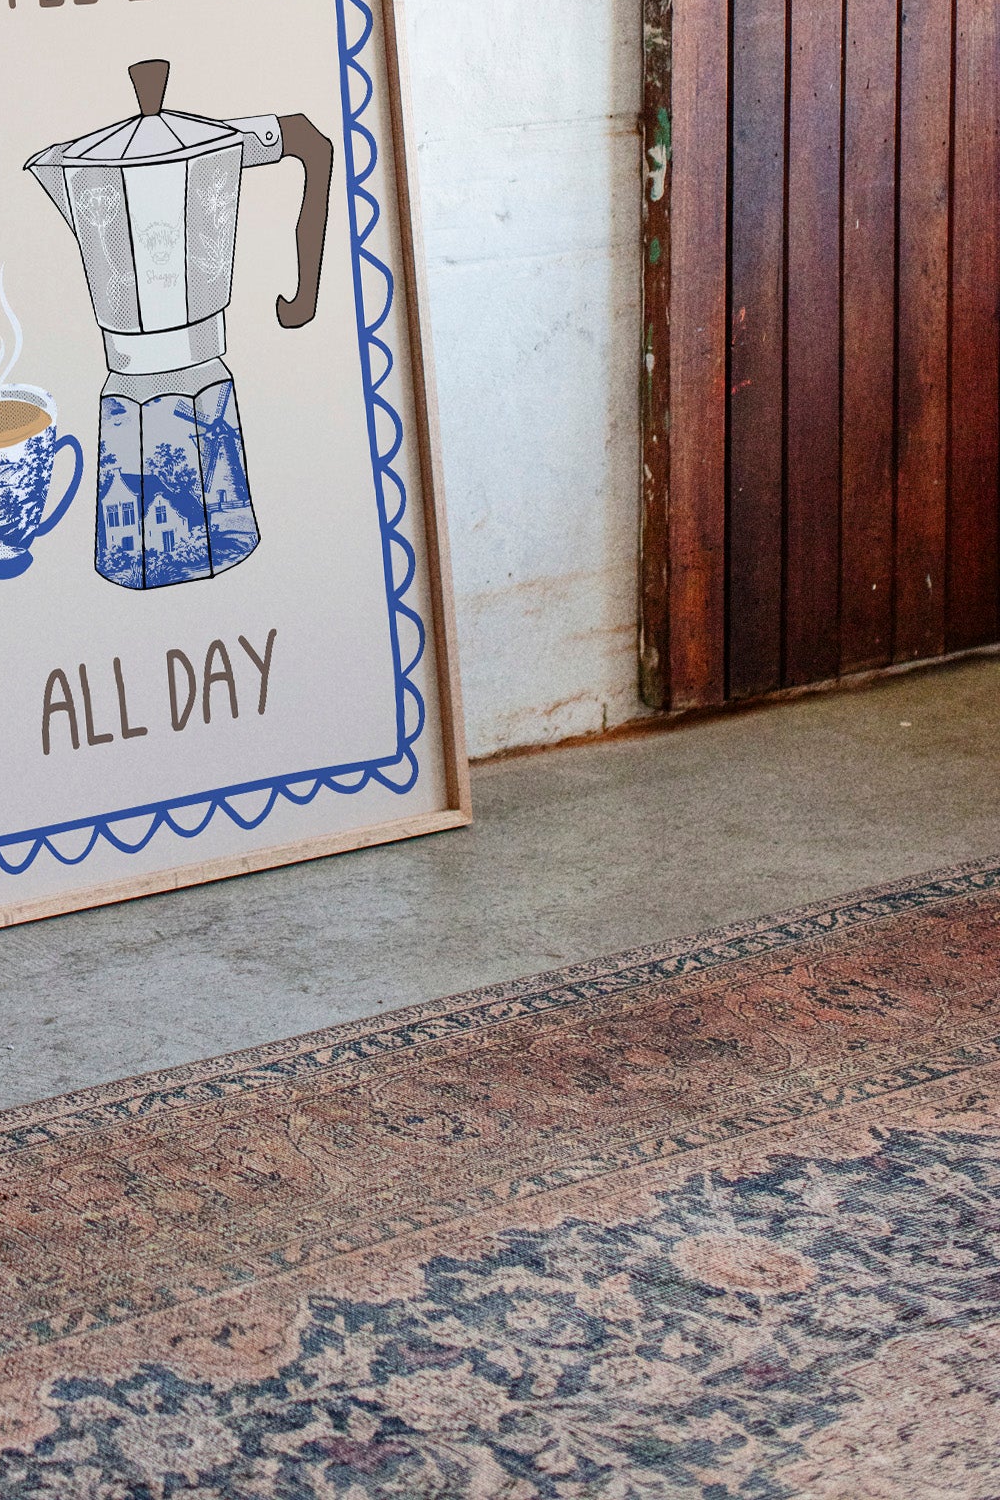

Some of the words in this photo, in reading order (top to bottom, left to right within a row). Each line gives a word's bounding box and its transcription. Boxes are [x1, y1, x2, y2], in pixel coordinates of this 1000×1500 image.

[145, 269, 180, 288] Shaggy
[41, 656, 149, 756] ALL
[166, 628, 278, 732] DAY
